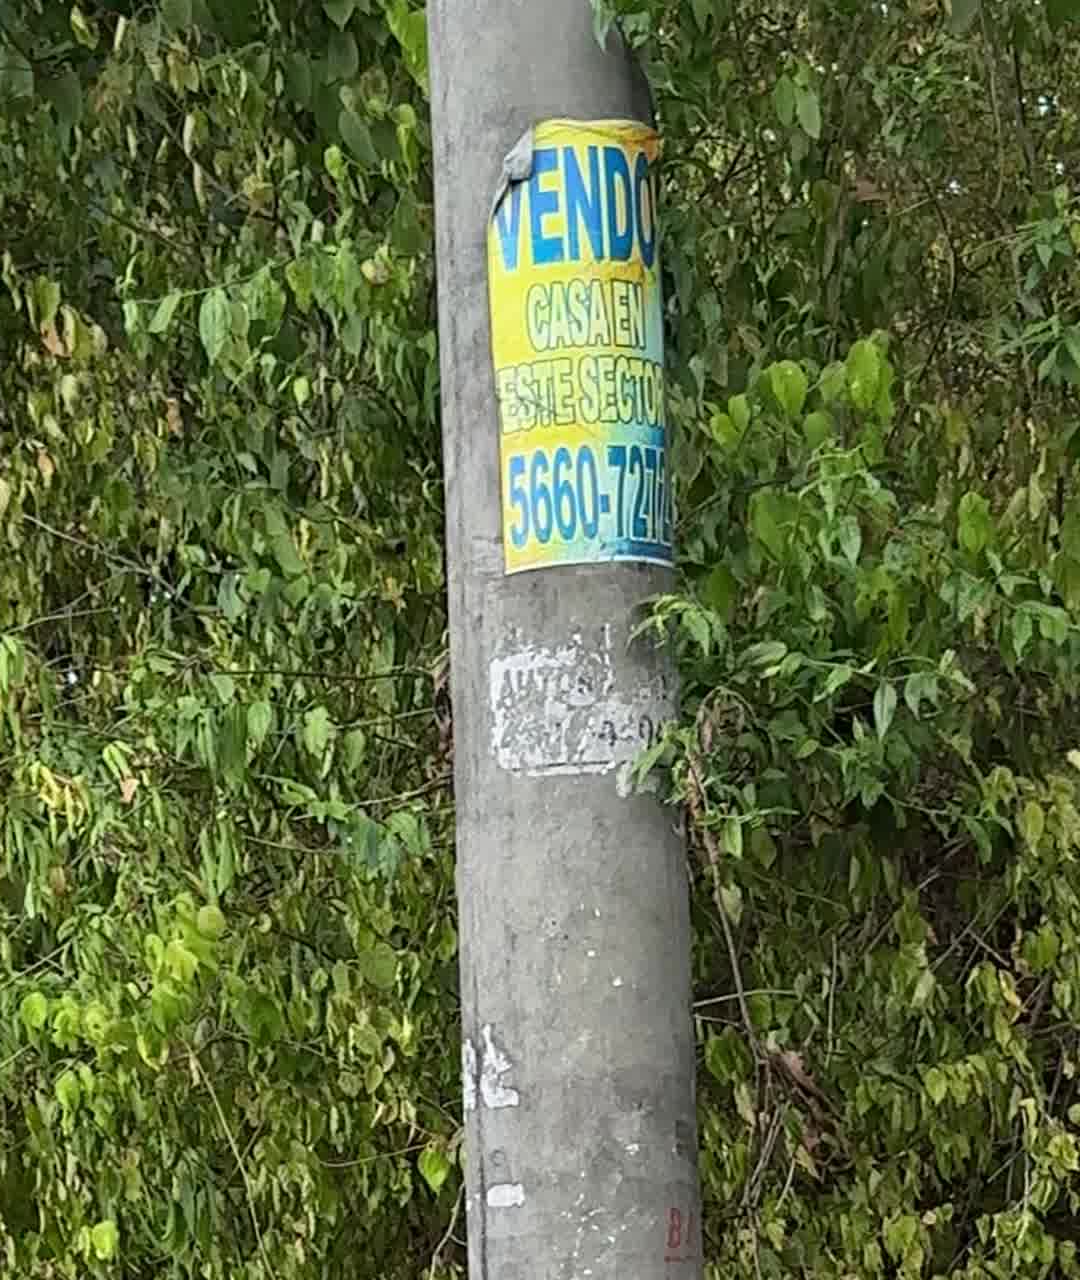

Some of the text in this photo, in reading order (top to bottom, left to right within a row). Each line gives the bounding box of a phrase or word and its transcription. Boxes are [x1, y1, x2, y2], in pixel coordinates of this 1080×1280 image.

[496, 145, 656, 271] VENDO
[526, 278, 646, 352] CASA EN
[497, 357, 576, 435] ESTE
